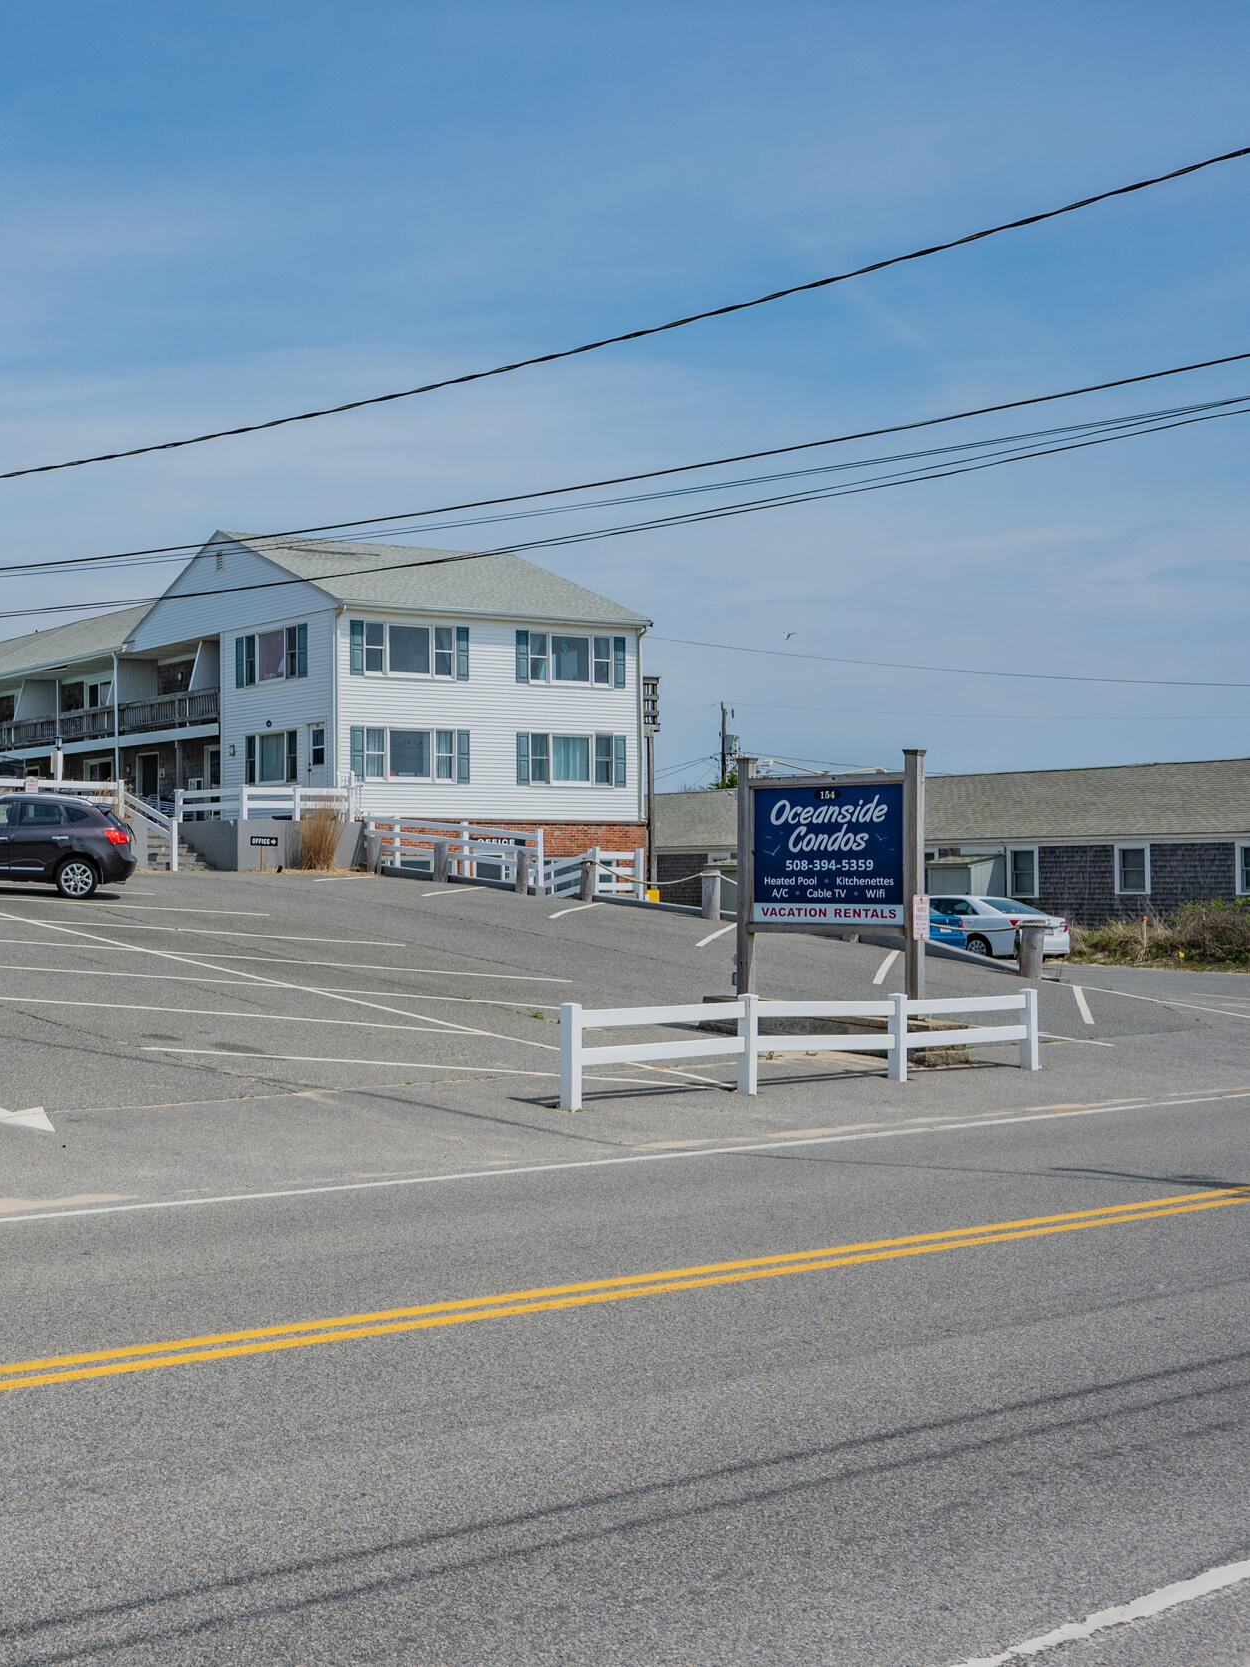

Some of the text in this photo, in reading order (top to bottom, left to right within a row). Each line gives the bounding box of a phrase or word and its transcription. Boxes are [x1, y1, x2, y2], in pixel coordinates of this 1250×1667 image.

[820, 790, 836, 800] 154
[770, 794, 888, 826] Oceanside
[252, 837, 270, 845] OFFICE
[788, 823, 869, 853] Condos
[785, 859, 874, 871] 508-394-5359
[764, 876, 895, 886] Heated Pool Kitchenettes
[771, 888, 886, 899] A/C Cable TV Wifi
[761, 906, 897, 919] VACATION RENTALS
